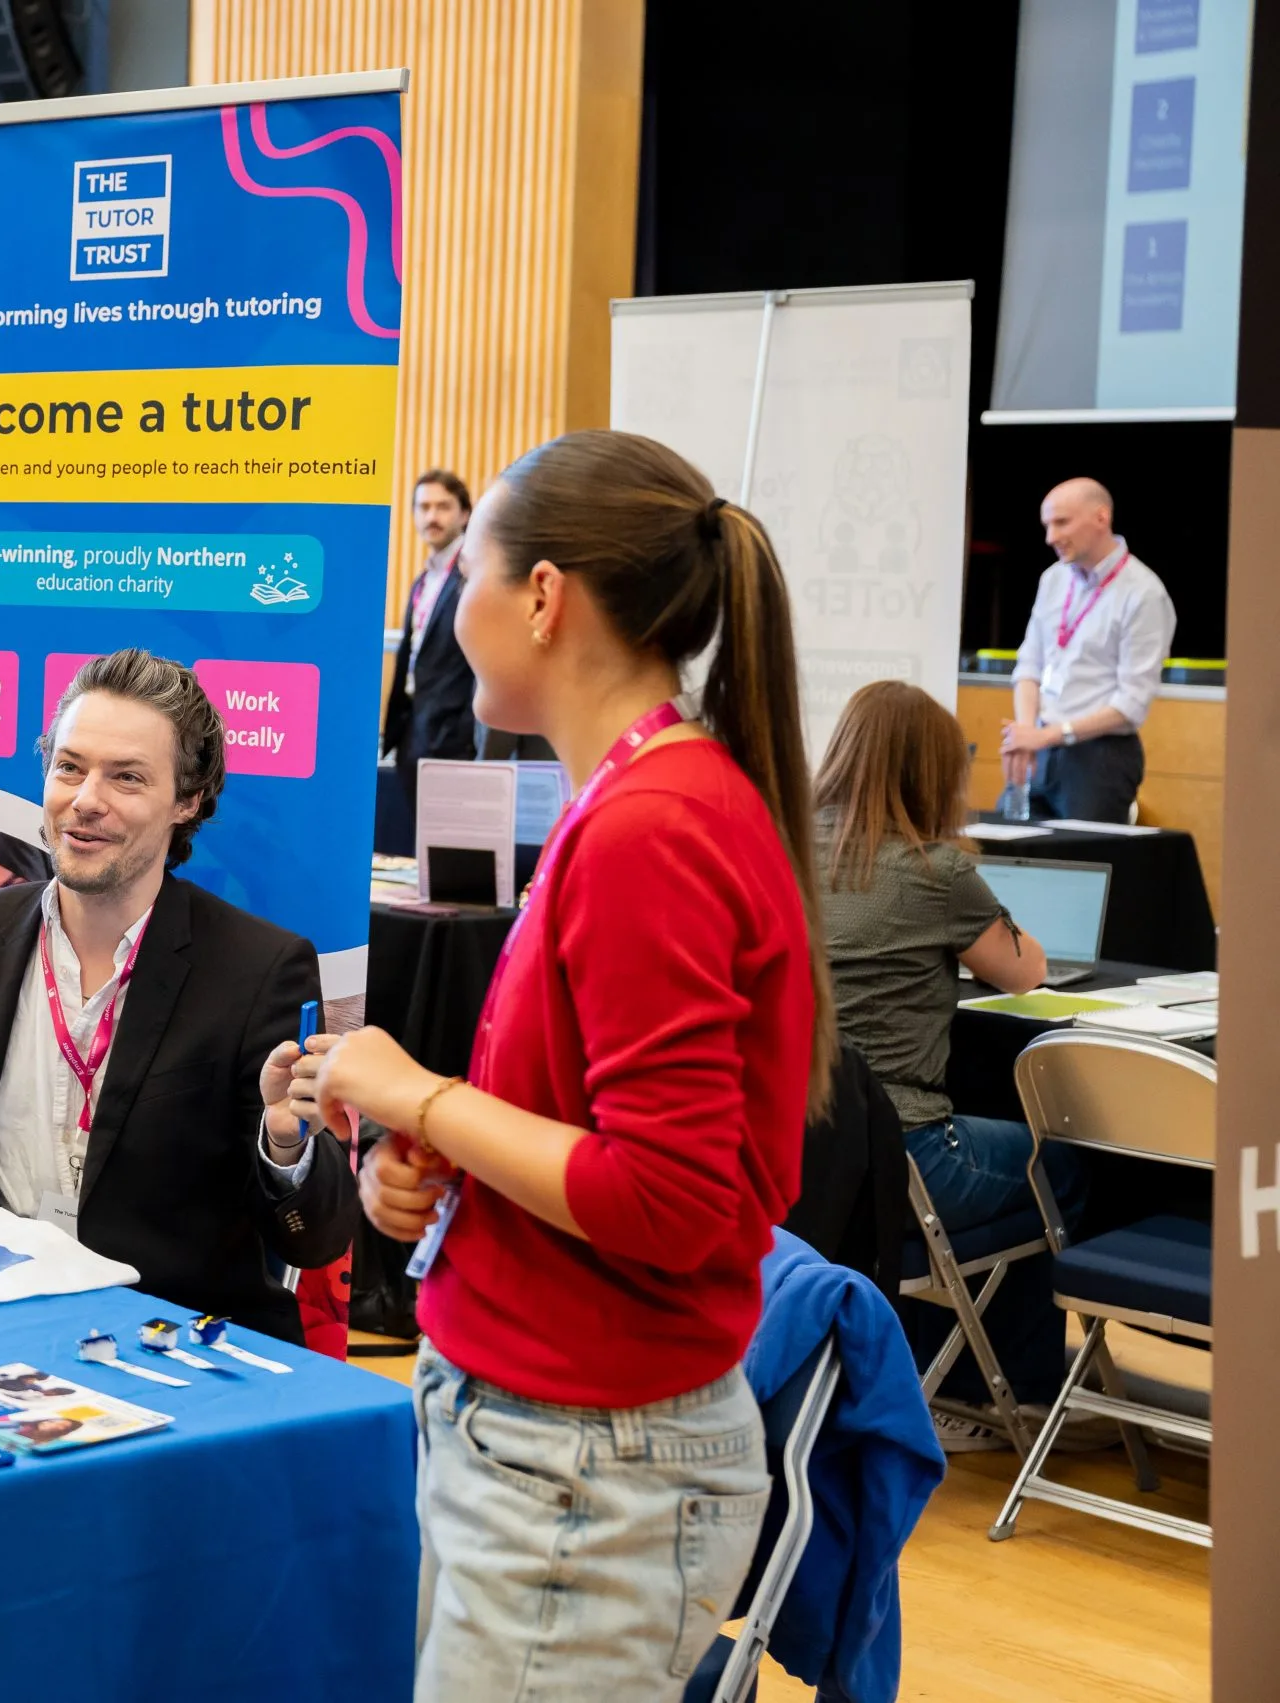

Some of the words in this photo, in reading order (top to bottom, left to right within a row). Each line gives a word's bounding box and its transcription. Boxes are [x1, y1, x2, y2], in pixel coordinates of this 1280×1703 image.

[86, 171, 128, 194] THE
[85, 207, 154, 229] TUTOR
[83, 243, 151, 266] TRUST
[73, 300, 122, 324] lives
[127, 297, 220, 325] through
[225, 292, 323, 320] tutoring
[139, 399, 165, 434] a
[183, 391, 312, 432] tutor
[23, 459, 53, 476] and
[56, 461, 106, 479] young
[111, 459, 168, 478] people
[172, 460, 188, 476] to
[194, 458, 240, 475] reach
[244, 457, 284, 475] their
[287, 456, 377, 477] potential
[83, 546, 152, 571] proudly
[156, 546, 247, 568] Northern
[36, 572, 114, 593] education
[117, 574, 174, 598] charity
[225, 689, 280, 712] Work
[224, 724, 285, 754] ocally
